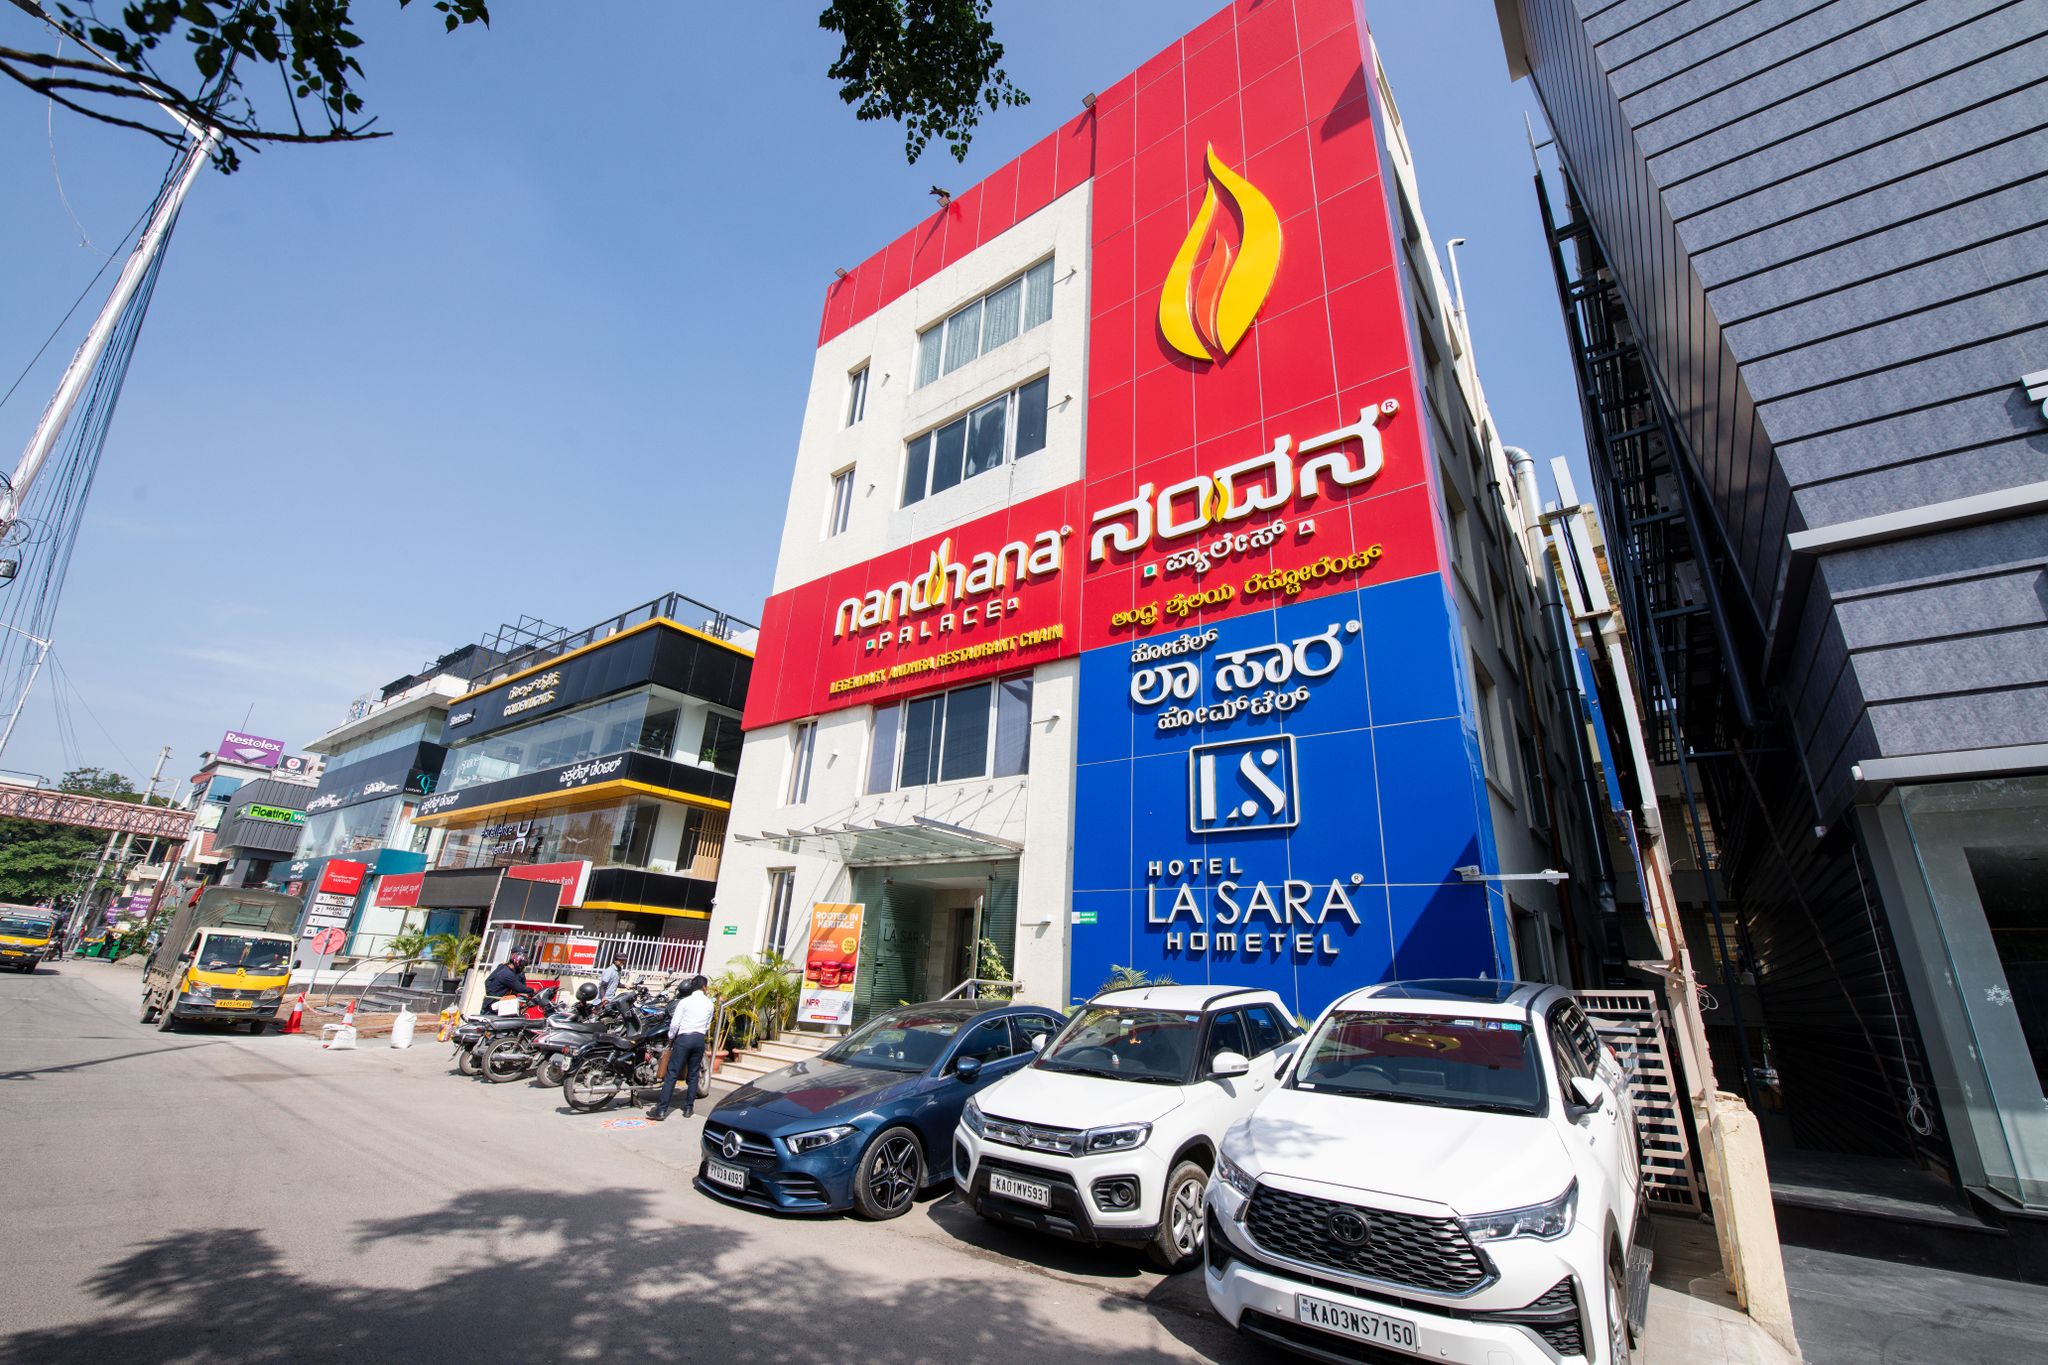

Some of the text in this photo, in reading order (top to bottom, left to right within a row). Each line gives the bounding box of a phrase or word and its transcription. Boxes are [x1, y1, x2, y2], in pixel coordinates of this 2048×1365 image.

[1090, 404, 1384, 561] ನಂದನ
[1165, 520, 1287, 575] ಪ್ಯಾಲೇಸ್
[833, 536, 1062, 637] nandhana
[1165, 583, 1235, 617] ಶೈಲಿಯ
[1243, 544, 1384, 595] ರೆಸ್ಟೋರೆಂಟ್
[878, 599, 1003, 650] PALACE
[1130, 628, 1220, 664] ಹೋಟೆಲ್
[829, 623, 1064, 694] LEGENDARY ANDHRA RESTAURANT CHAIN
[1130, 622, 1344, 706] ಲಾ ಸಾರ
[225, 732, 281, 752] Restolex
[250, 805, 291, 820] Floating
[1148, 857, 1244, 877] HOTEL
[815, 911, 859, 921] ROOTED IN
[1148, 878, 1362, 925] LA SARA
[817, 920, 856, 929] HERITAGE
[1166, 931, 1340, 954] HOMETEL
[805, 998, 820, 1008] NPR
[1310, 1302, 1412, 1346] KA03NS7150
